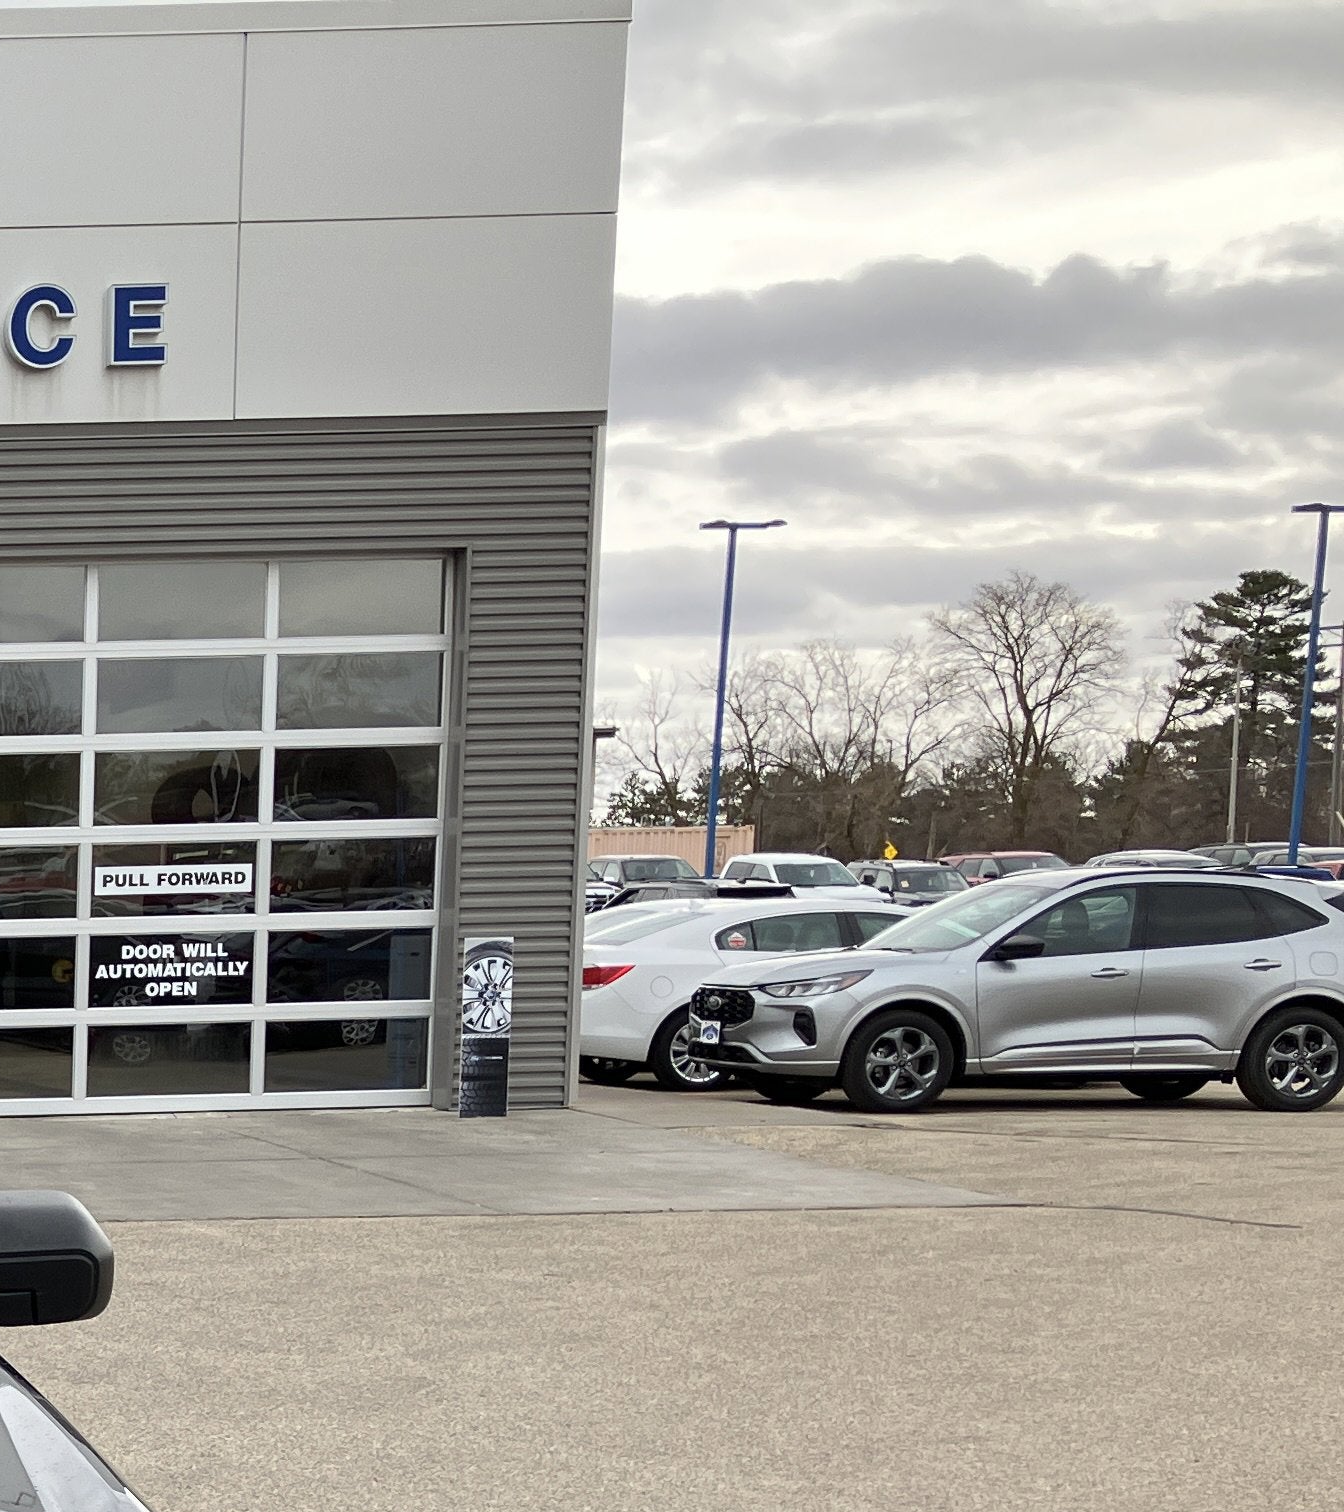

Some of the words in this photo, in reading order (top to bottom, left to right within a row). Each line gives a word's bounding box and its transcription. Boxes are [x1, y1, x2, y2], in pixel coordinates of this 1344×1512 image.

[102, 873, 150, 888] PULL
[157, 871, 247, 887] FORWARD
[121, 944, 175, 960] DOOR
[182, 942, 229, 958] WILL
[94, 960, 249, 979] AUTOMATICALLY
[144, 981, 198, 997] OPEN
